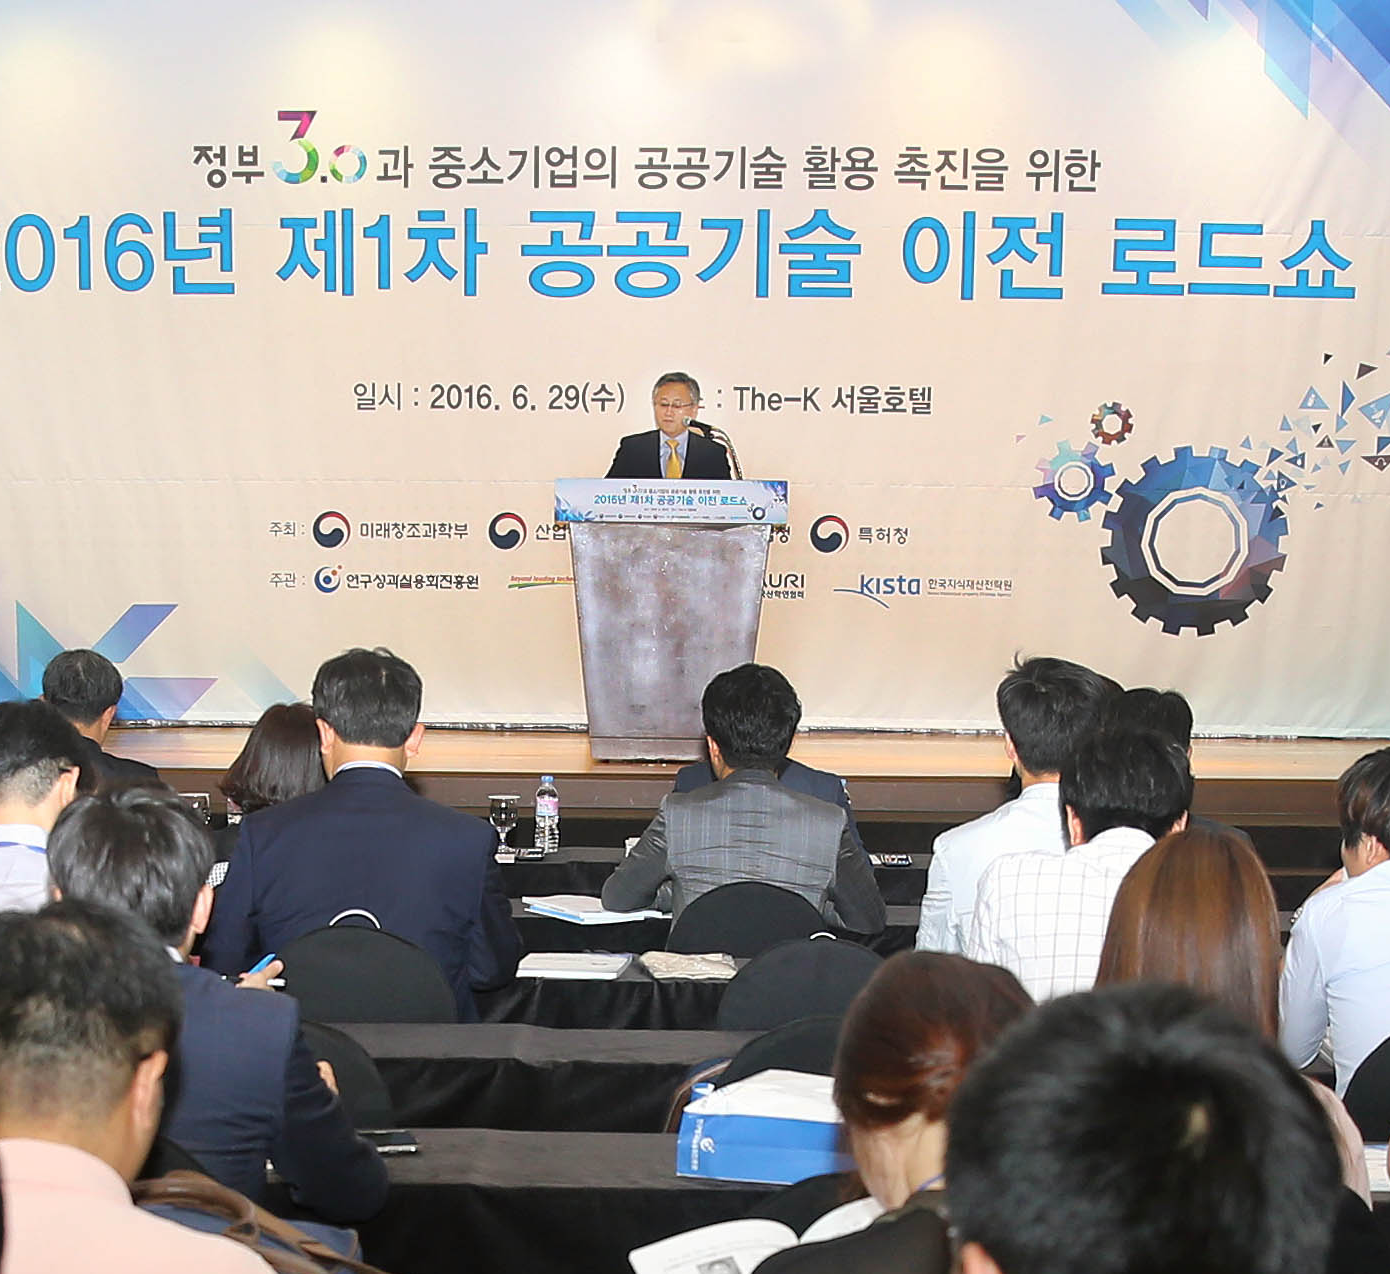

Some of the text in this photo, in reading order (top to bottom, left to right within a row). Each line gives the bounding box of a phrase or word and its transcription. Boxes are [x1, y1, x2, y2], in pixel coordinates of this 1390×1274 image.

[428, 145, 617, 190] 중소기업의
[634, 145, 788, 190] 공공기술
[802, 145, 879, 191] 활용
[893, 146, 1009, 192] 촉진을
[1025, 148, 1102, 193] 위한
[275, 207, 489, 297] 제1차
[520, 208, 862, 299] 공공기술
[902, 210, 1064, 301] 이전
[1100, 217, 1357, 300] 로드쇼
[353, 382, 401, 411] 일시
[429, 383, 500, 411] 2016.
[512, 384, 536, 412] 6.
[548, 381, 625, 414] 29(수)
[732, 386, 821, 412] The-K
[831, 385, 932, 415] 서울호텔
[269, 521, 296, 537] 주최
[360, 522, 469, 540] 미래창조과학부
[857, 526, 909, 545] 특허청
